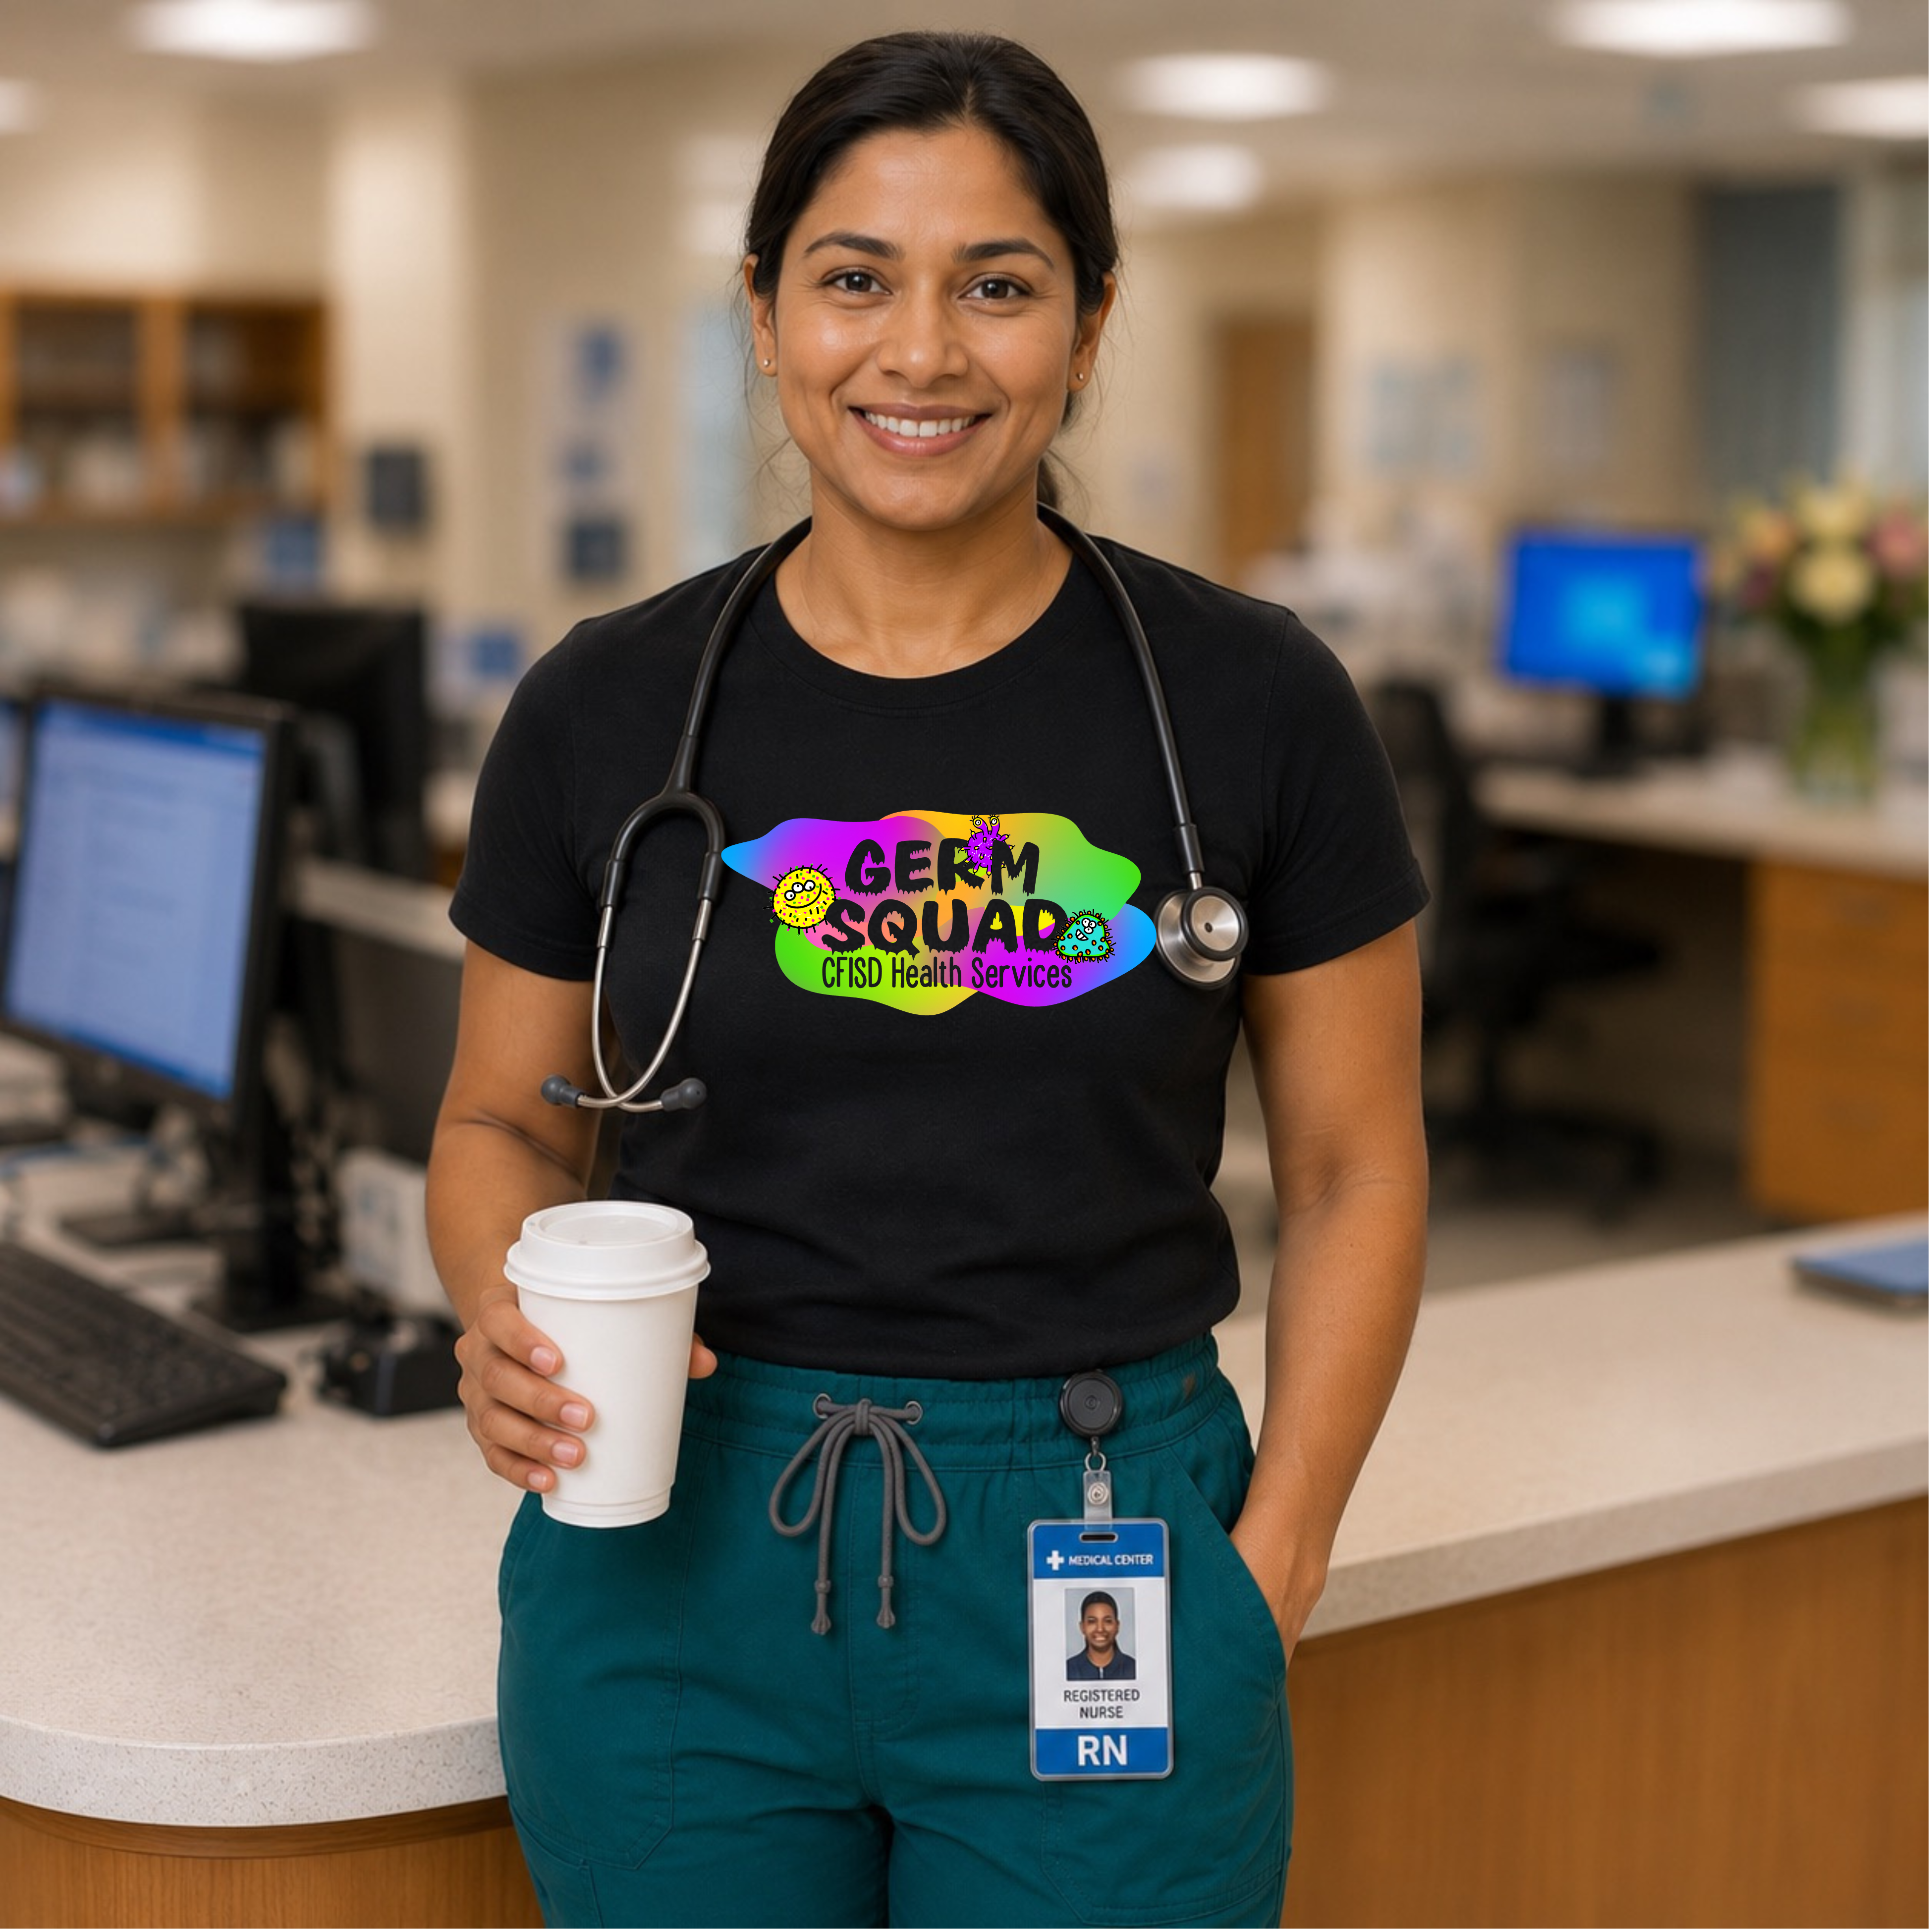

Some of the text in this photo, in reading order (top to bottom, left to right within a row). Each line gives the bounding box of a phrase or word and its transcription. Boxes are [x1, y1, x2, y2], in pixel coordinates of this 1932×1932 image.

[844, 838, 1040, 896] GERM
[821, 898, 1068, 958] SQUAD
[822, 957, 1072, 989] CFISD Health Services
[1069, 1554, 1154, 1565] MEDICAL CENTER
[1064, 1689, 1140, 1702] REGISTERED
[1079, 1706, 1123, 1719] NURSE
[1077, 1735, 1128, 1766] RN
